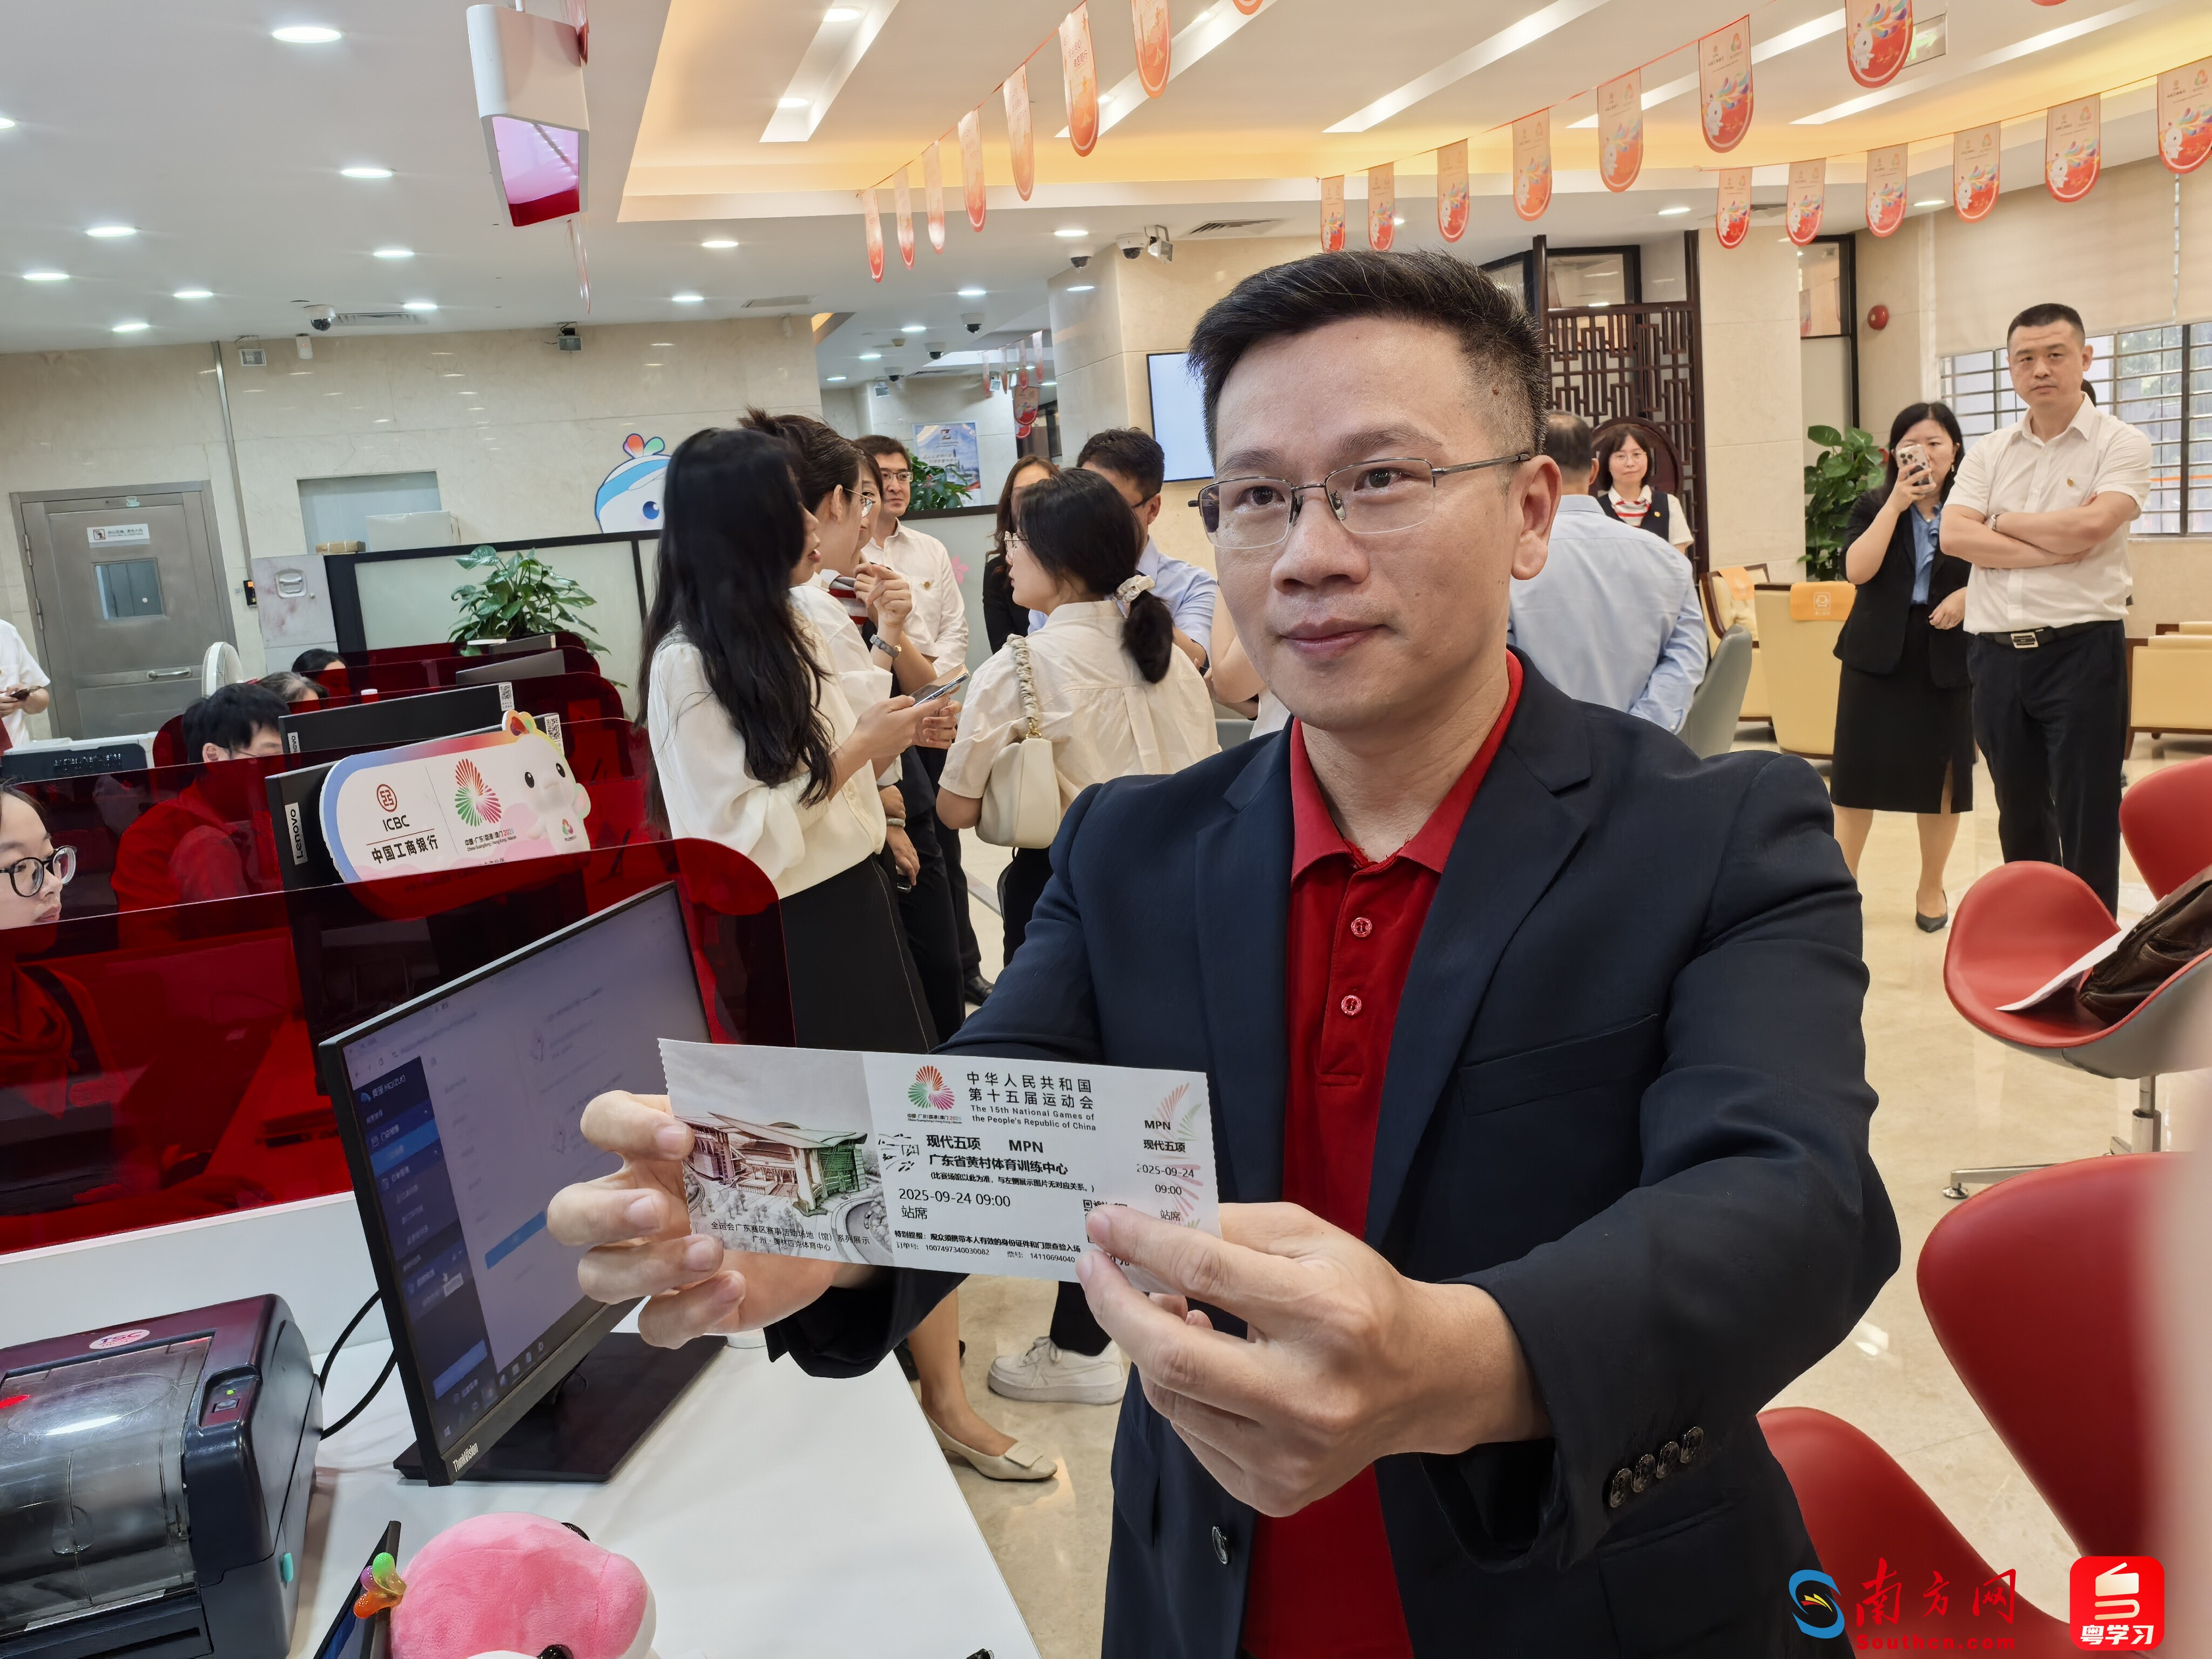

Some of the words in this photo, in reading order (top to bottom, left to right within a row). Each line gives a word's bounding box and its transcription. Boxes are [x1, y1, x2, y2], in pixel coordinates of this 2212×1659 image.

[383, 815, 409, 832] ICBC
[291, 809, 303, 859] Lenovo
[372, 835, 438, 864] 中国工商银行
[967, 1071, 1092, 1094] 中华人民共和国
[968, 1087, 1094, 1110] 第十五届运动会
[970, 1104, 986, 1112] The
[1013, 1108, 1049, 1117] National
[1053, 1110, 1082, 1120] Games
[1086, 1112, 1094, 1121] of
[987, 1116, 1022, 1126] People's
[1024, 1118, 1060, 1128] Republic
[1062, 1121, 1070, 1129] of
[1073, 1122, 1096, 1131] China
[1144, 1120, 1171, 1130] MPN
[926, 1134, 981, 1150] 现代五项
[1009, 1139, 1043, 1153] MPN
[1143, 1139, 1186, 1153] 现代五项
[929, 1154, 1068, 1175] 广东省黄村体育训练中心
[1137, 1164, 1195, 1178] 2025-09-24
[899, 1189, 972, 1204] 2025-09-24
[976, 1193, 1011, 1207] 09:00
[1155, 1185, 1182, 1195] 09:00
[901, 1205, 928, 1219] 站席
[1161, 1210, 1181, 1221] 站席
[1030, 1253, 1075, 1263] 14110694040
[453, 1443, 478, 1472] ThinkVision
